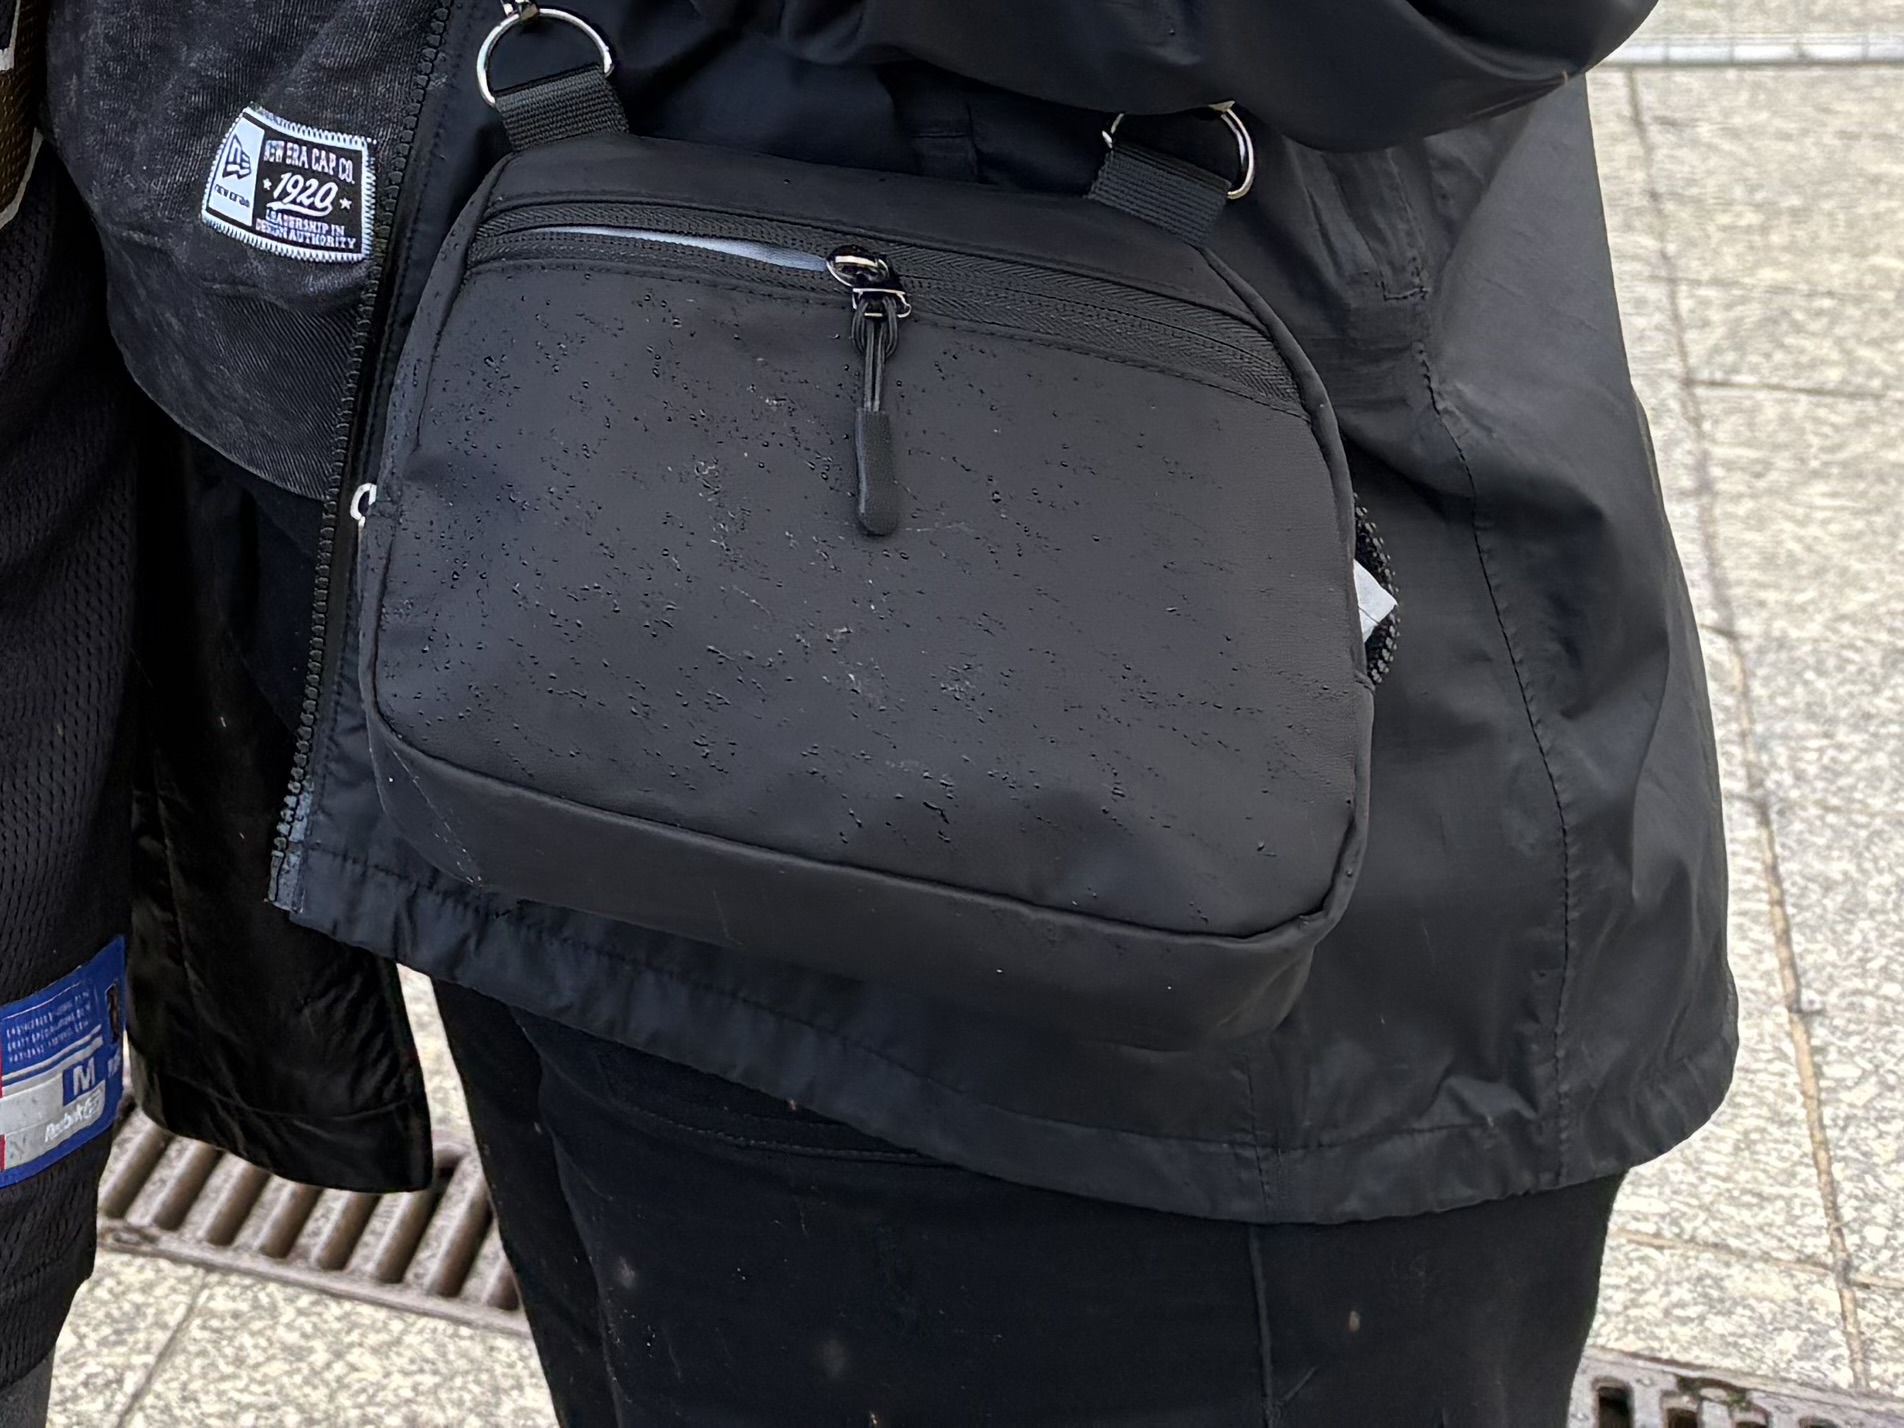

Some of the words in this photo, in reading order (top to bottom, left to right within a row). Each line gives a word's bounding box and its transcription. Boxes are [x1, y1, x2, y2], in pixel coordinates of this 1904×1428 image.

[286, 142, 309, 169] ERA
[311, 147, 337, 176] CAP
[273, 171, 339, 210] 1920
[290, 229, 357, 250] AUTHORITY
[331, 224, 345, 237] IN
[72, 1057, 96, 1096] M
